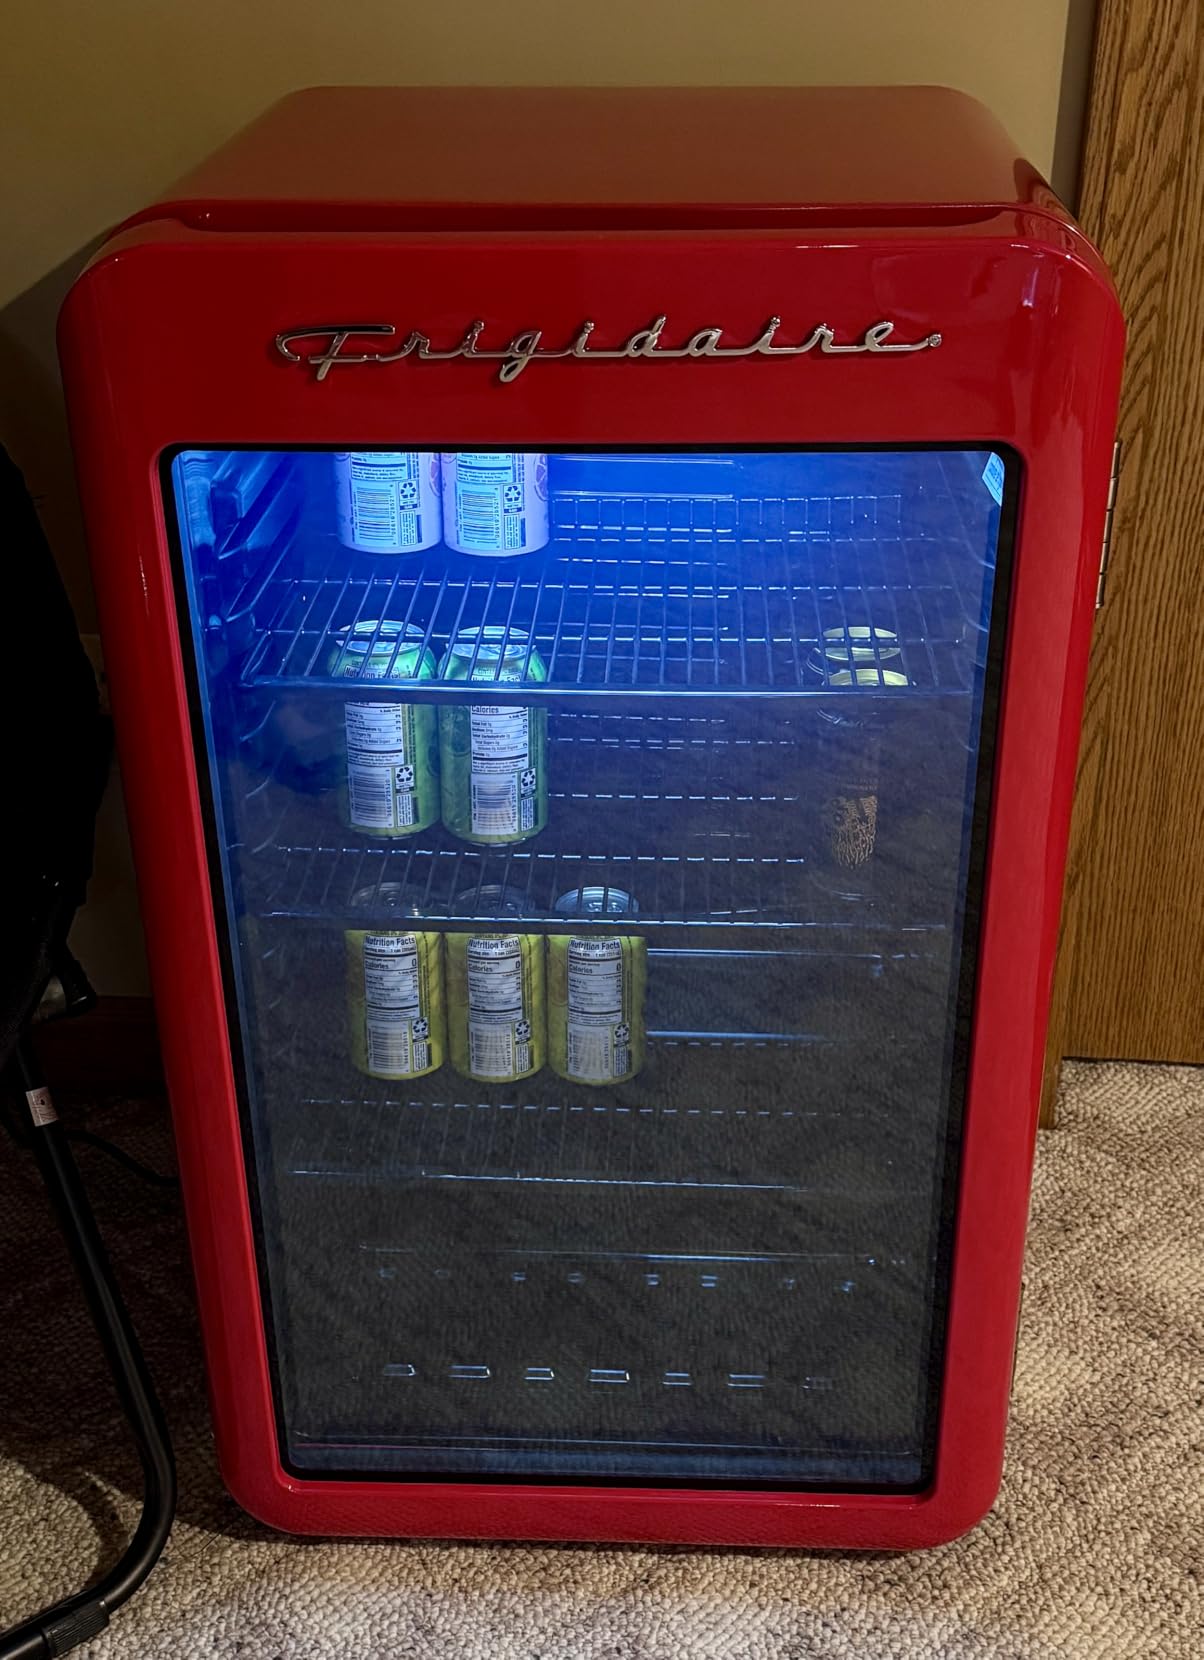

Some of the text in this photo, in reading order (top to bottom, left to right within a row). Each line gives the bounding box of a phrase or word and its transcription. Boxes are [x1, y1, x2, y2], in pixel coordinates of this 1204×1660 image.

[274, 315, 941, 383] Frigidaire
[472, 705, 499, 713] Calories
[365, 935, 416, 947] Nutrition Facts
[469, 939, 519, 949] Nutrition Facts
[570, 940, 620, 950] Nutrition Facts
[411, 958, 417, 967] 0
